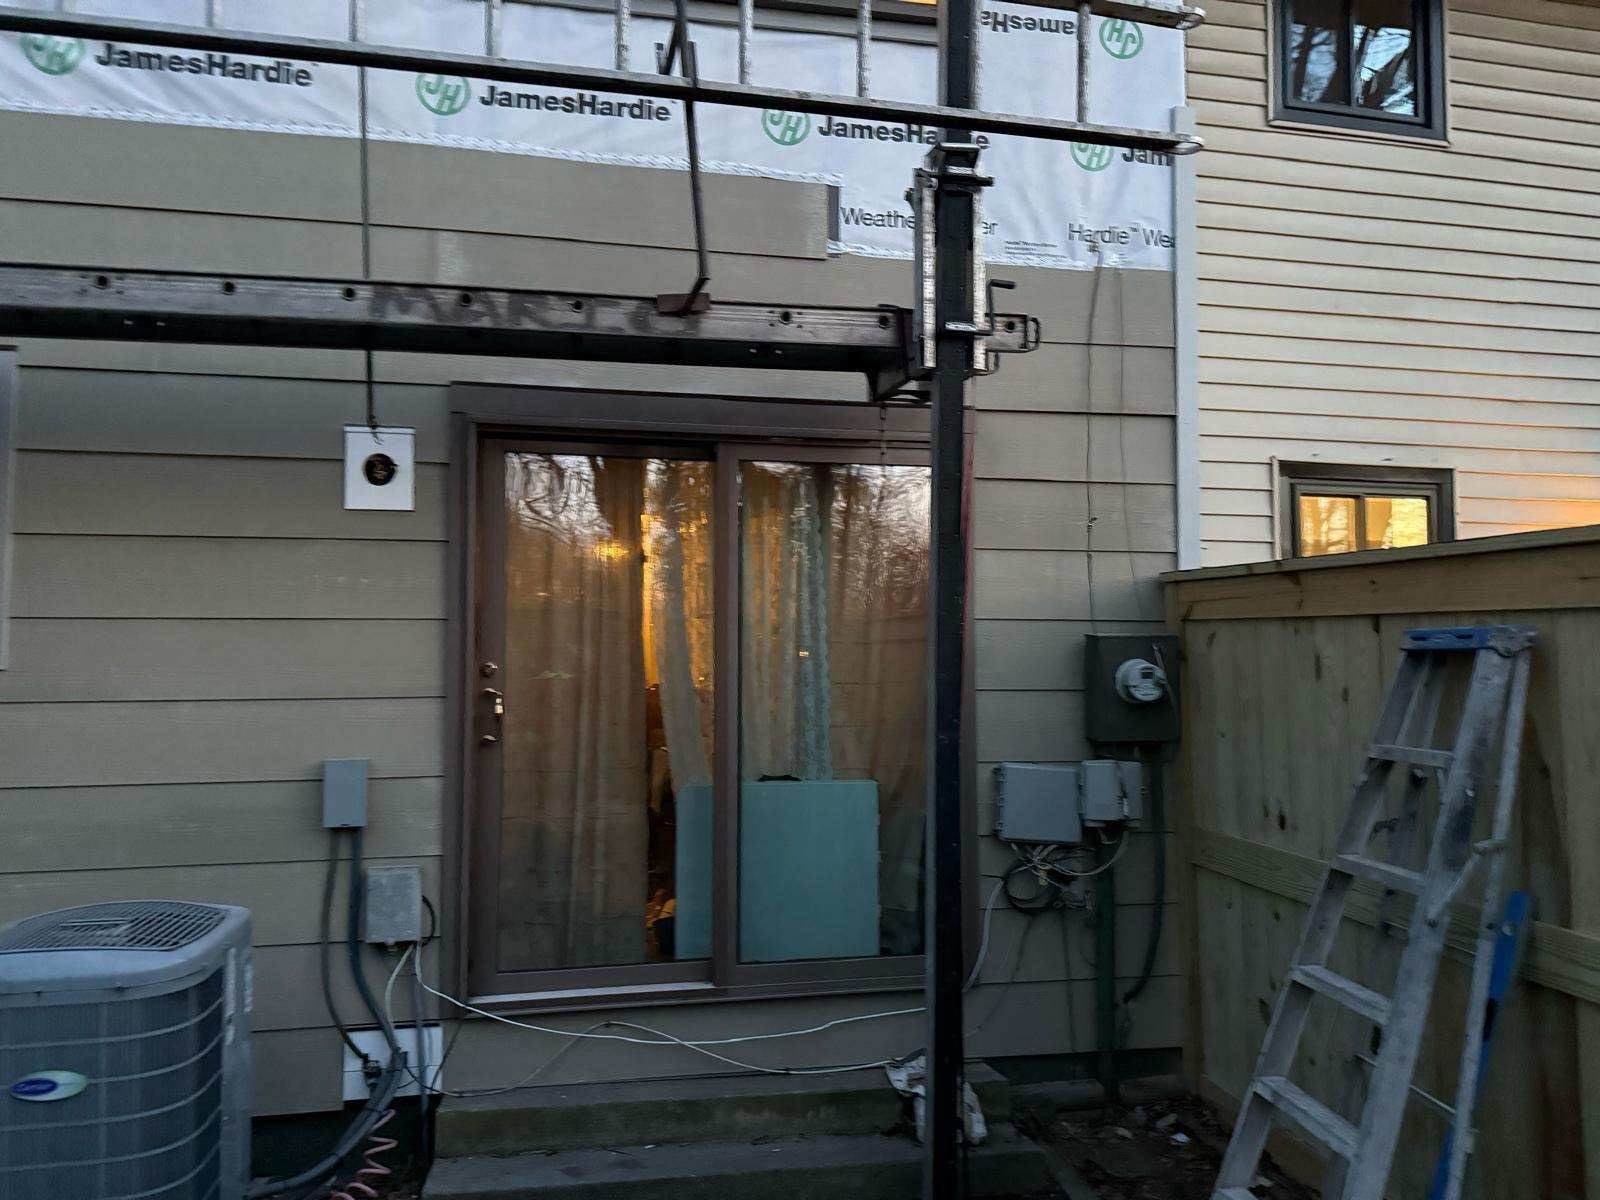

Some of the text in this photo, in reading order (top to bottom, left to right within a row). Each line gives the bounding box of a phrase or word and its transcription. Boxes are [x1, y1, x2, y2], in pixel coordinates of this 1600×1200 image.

[981, 10, 1075, 35] amesHa
[817, 115, 990, 149] JamesHae
[840, 207, 915, 230] Weathe
